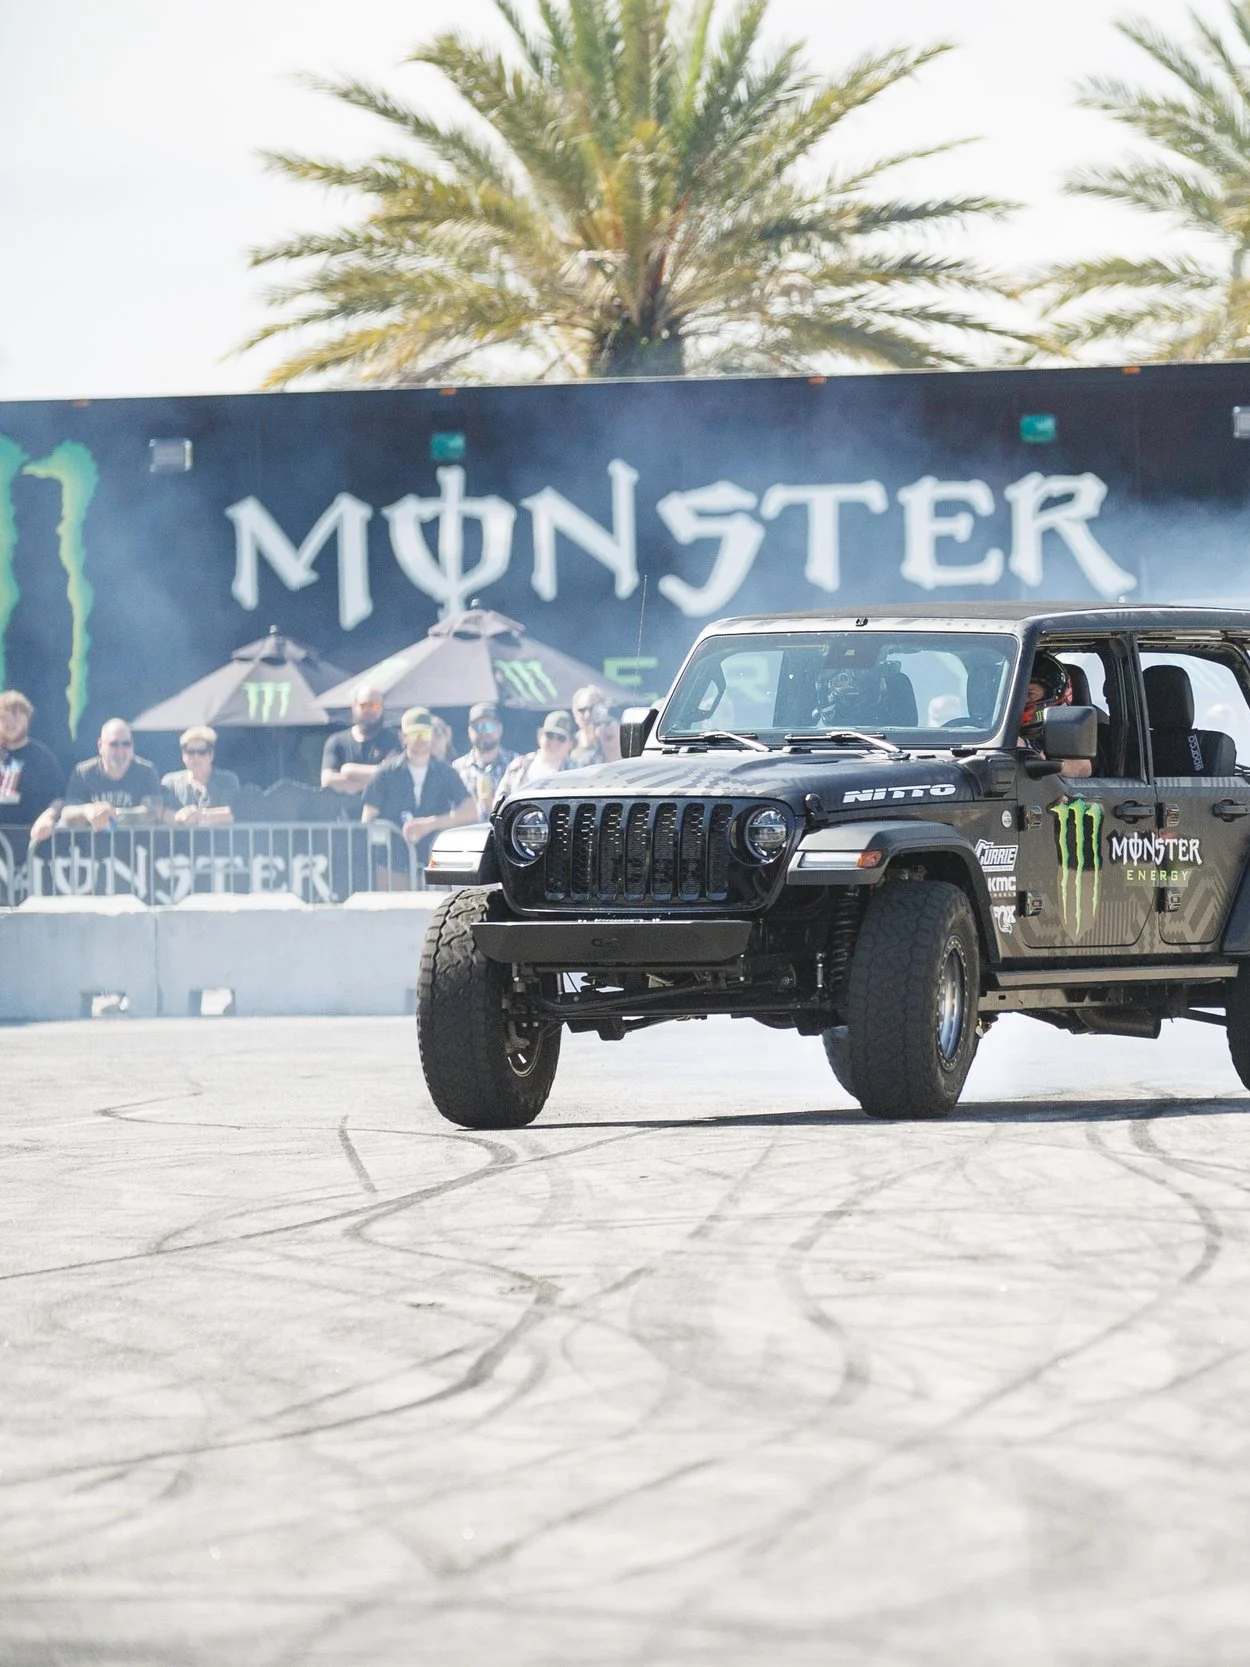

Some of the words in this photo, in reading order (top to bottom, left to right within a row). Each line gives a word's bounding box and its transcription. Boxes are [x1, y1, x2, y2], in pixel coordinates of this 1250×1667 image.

[224, 458, 1137, 630] MONSTER
[842, 783, 957, 803] NITTO
[975, 842, 1016, 865] CURRIE
[1111, 831, 1203, 867] MONSTER
[987, 876, 1017, 892] KMC
[1126, 869, 1190, 881] ENERGY
